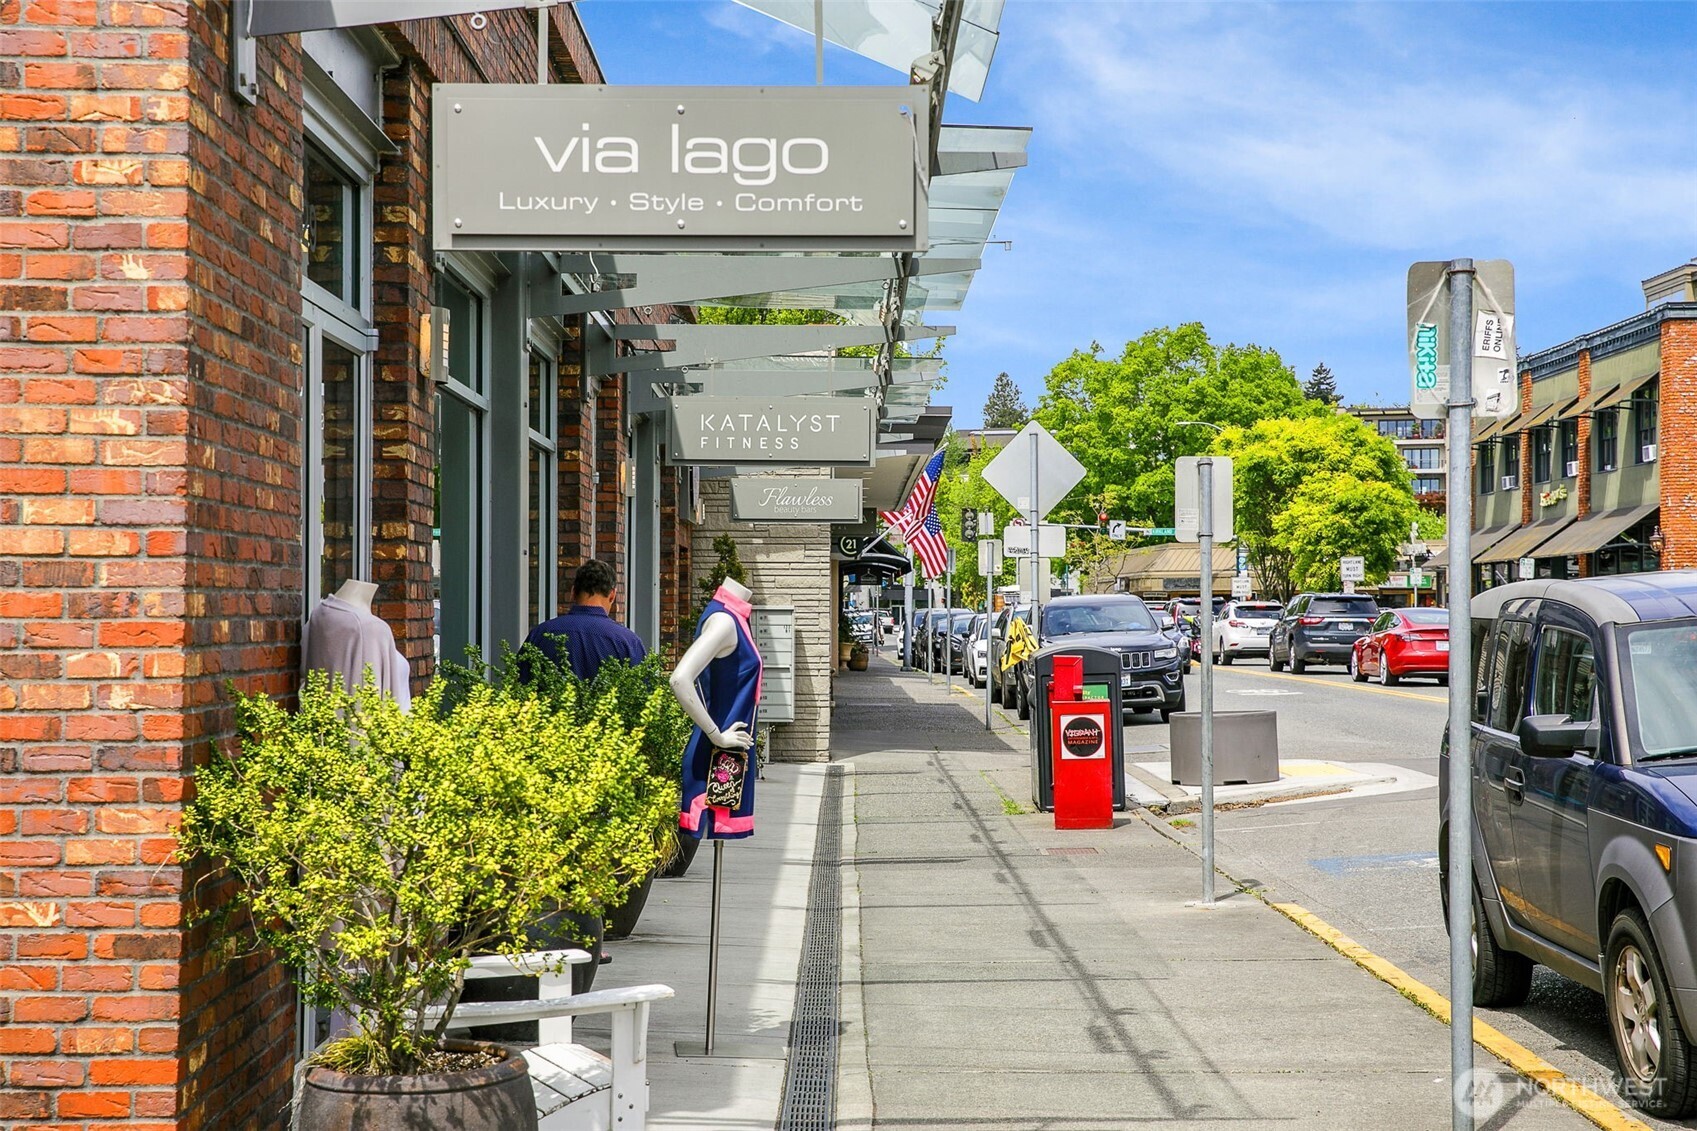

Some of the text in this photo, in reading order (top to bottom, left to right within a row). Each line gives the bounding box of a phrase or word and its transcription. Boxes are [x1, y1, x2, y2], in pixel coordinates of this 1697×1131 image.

[534, 122, 829, 185] via lago
[499, 192, 863, 214] Luxury Style Comfort
[1482, 319, 1494, 351] ERIFFS
[701, 413, 840, 432] KATALYST
[700, 437, 799, 450] FITNESS
[758, 486, 834, 507] Flawless
[774, 506, 817, 515] beauty bars
